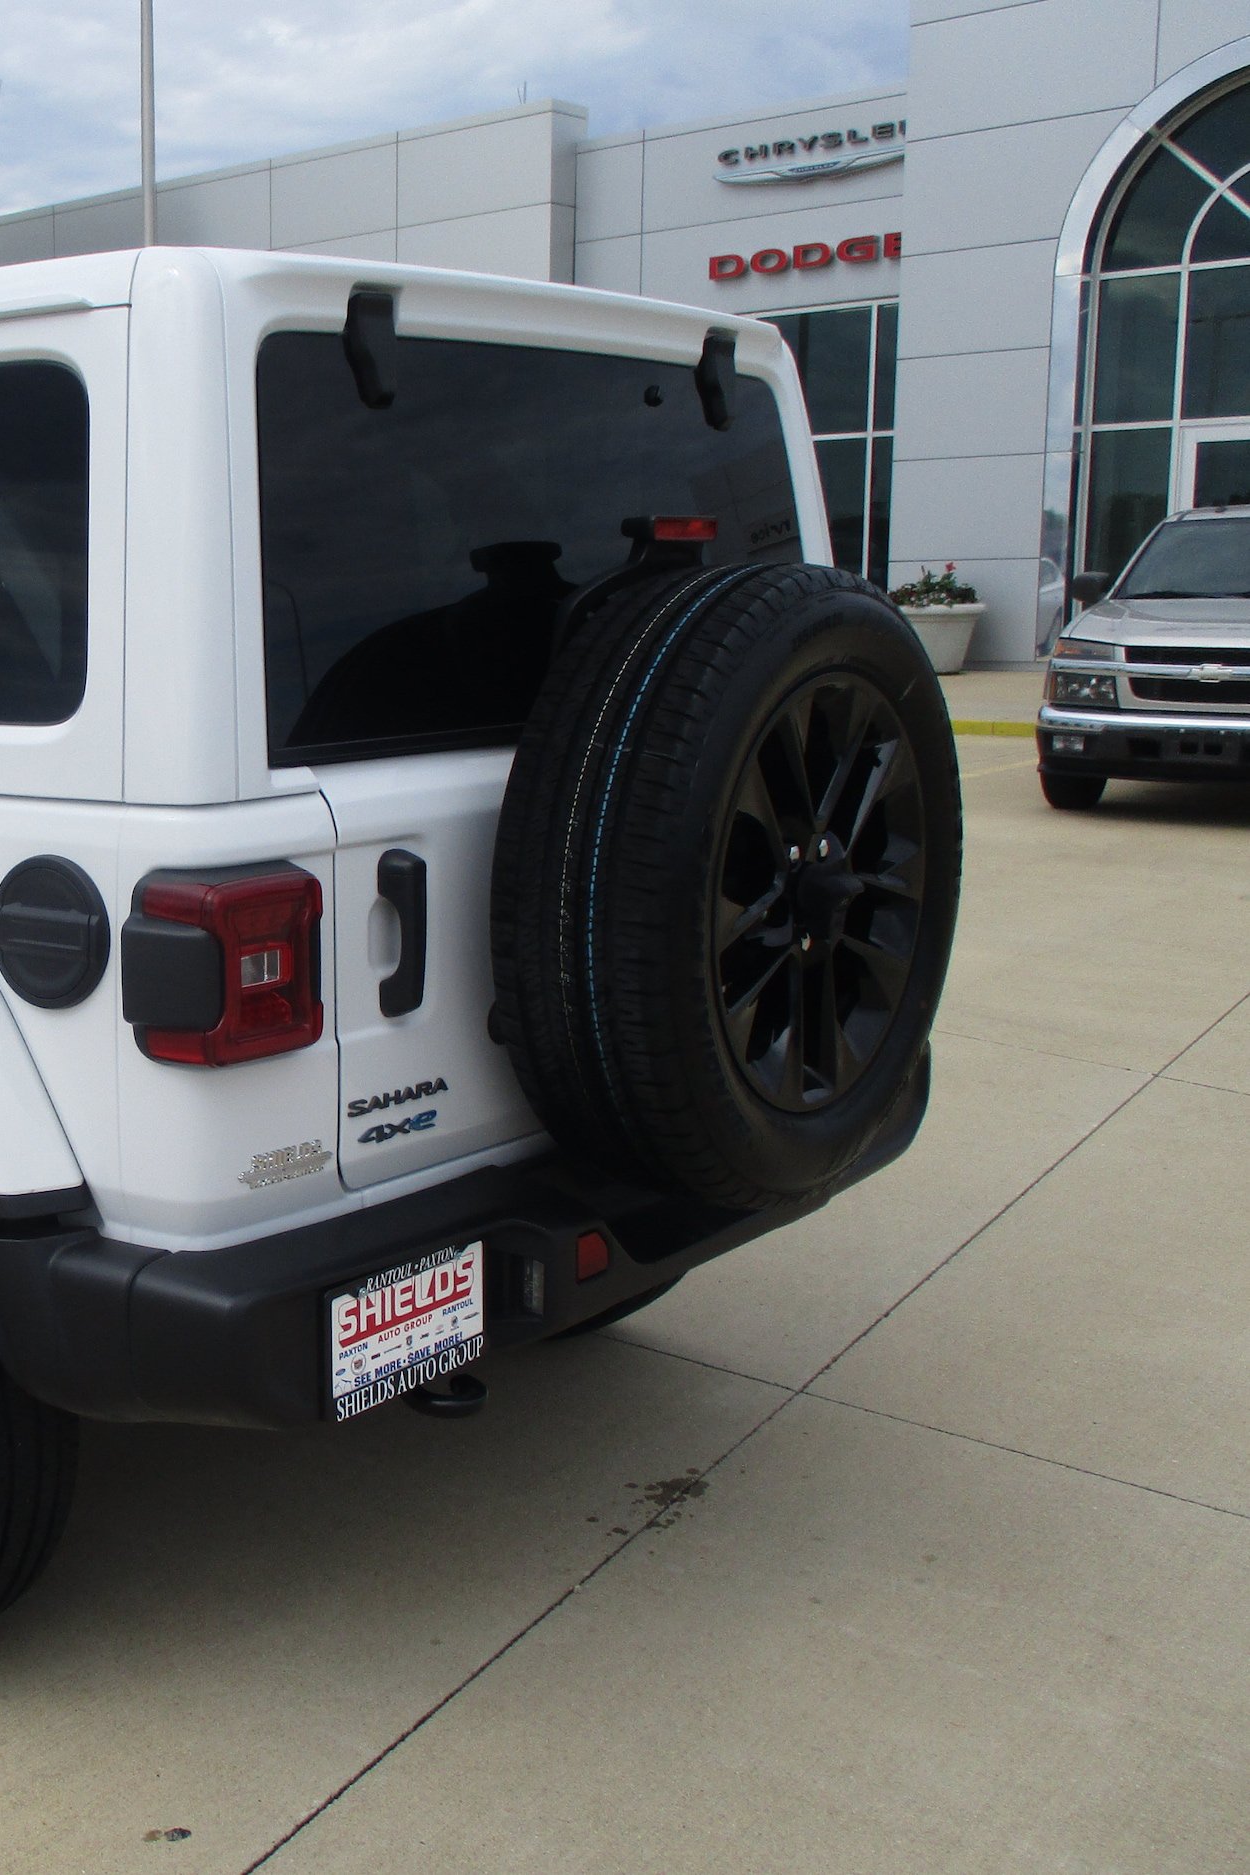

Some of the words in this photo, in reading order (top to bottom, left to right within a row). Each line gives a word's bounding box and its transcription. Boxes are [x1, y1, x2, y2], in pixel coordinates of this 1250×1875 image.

[347, 1077, 448, 1118] SAHARA
[366, 1262, 413, 1293] RANTOUL
[419, 1245, 456, 1273] PAXTON
[337, 1252, 475, 1344] SHIELDS
[442, 1298, 473, 1316] RANTOUL
[338, 1342, 368, 1360] PAXTON
[378, 1327, 401, 1344] AUTO
[404, 1314, 433, 1332] GROUP
[336, 1375, 395, 1422] SHIELDS
[397, 1358, 437, 1395] AUTO
[438, 1335, 484, 1375] GROUP
[354, 1371, 371, 1387] SEE
[375, 1358, 402, 1378] MORE
[407, 1345, 431, 1363] SAVE
[434, 1331, 463, 1353] MORE!
